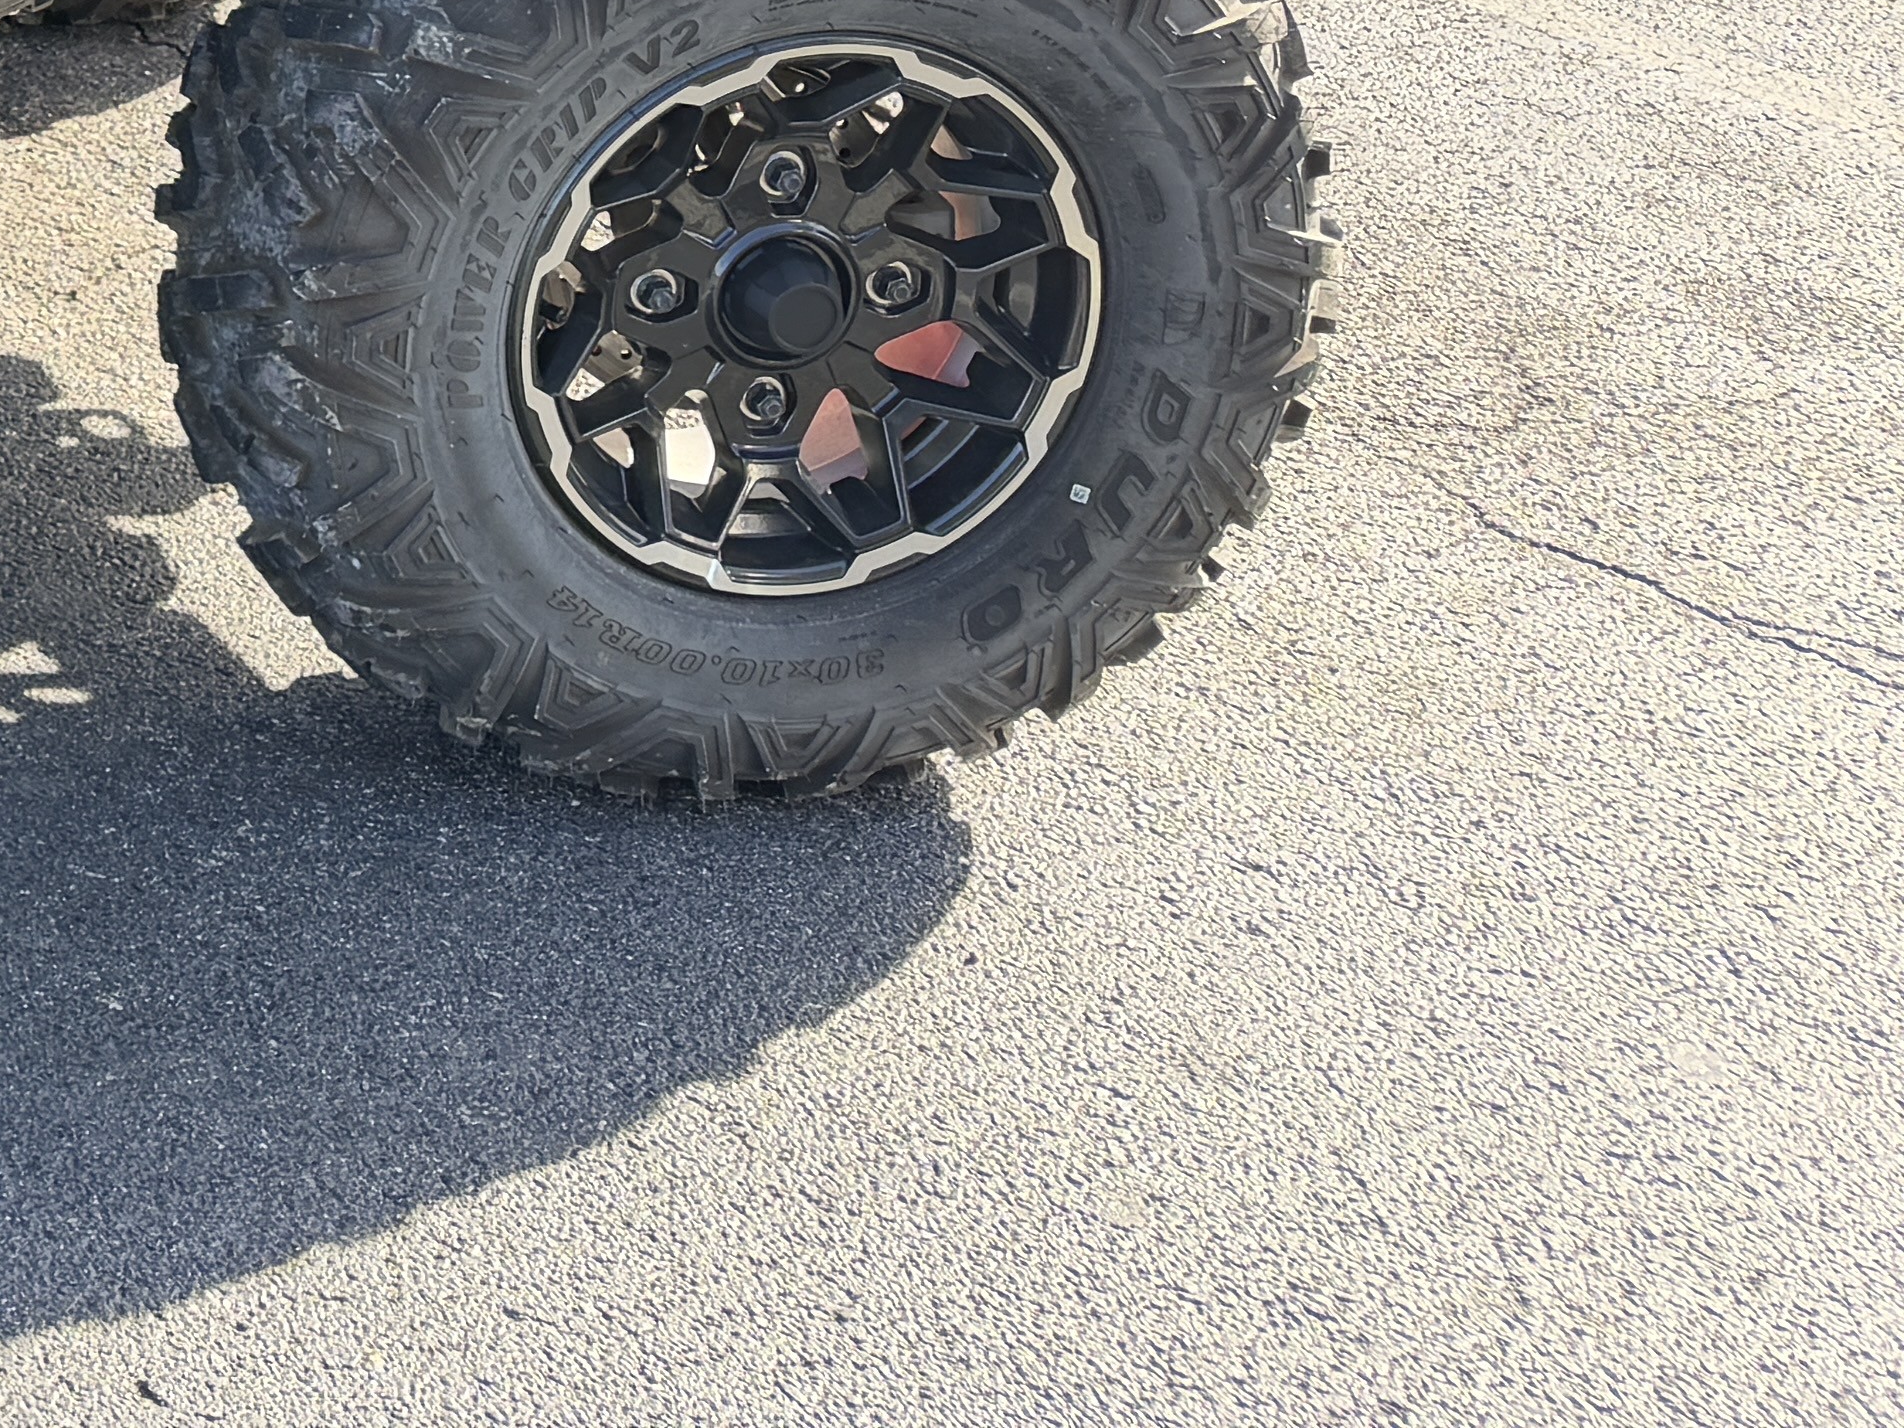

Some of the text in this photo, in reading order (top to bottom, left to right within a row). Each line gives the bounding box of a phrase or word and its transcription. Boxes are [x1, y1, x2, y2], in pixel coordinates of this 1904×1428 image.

[446, 19, 702, 410] POWER GRIP V2
[546, 584, 886, 688] 30x10.00R14
[961, 367, 1192, 643] DURO
